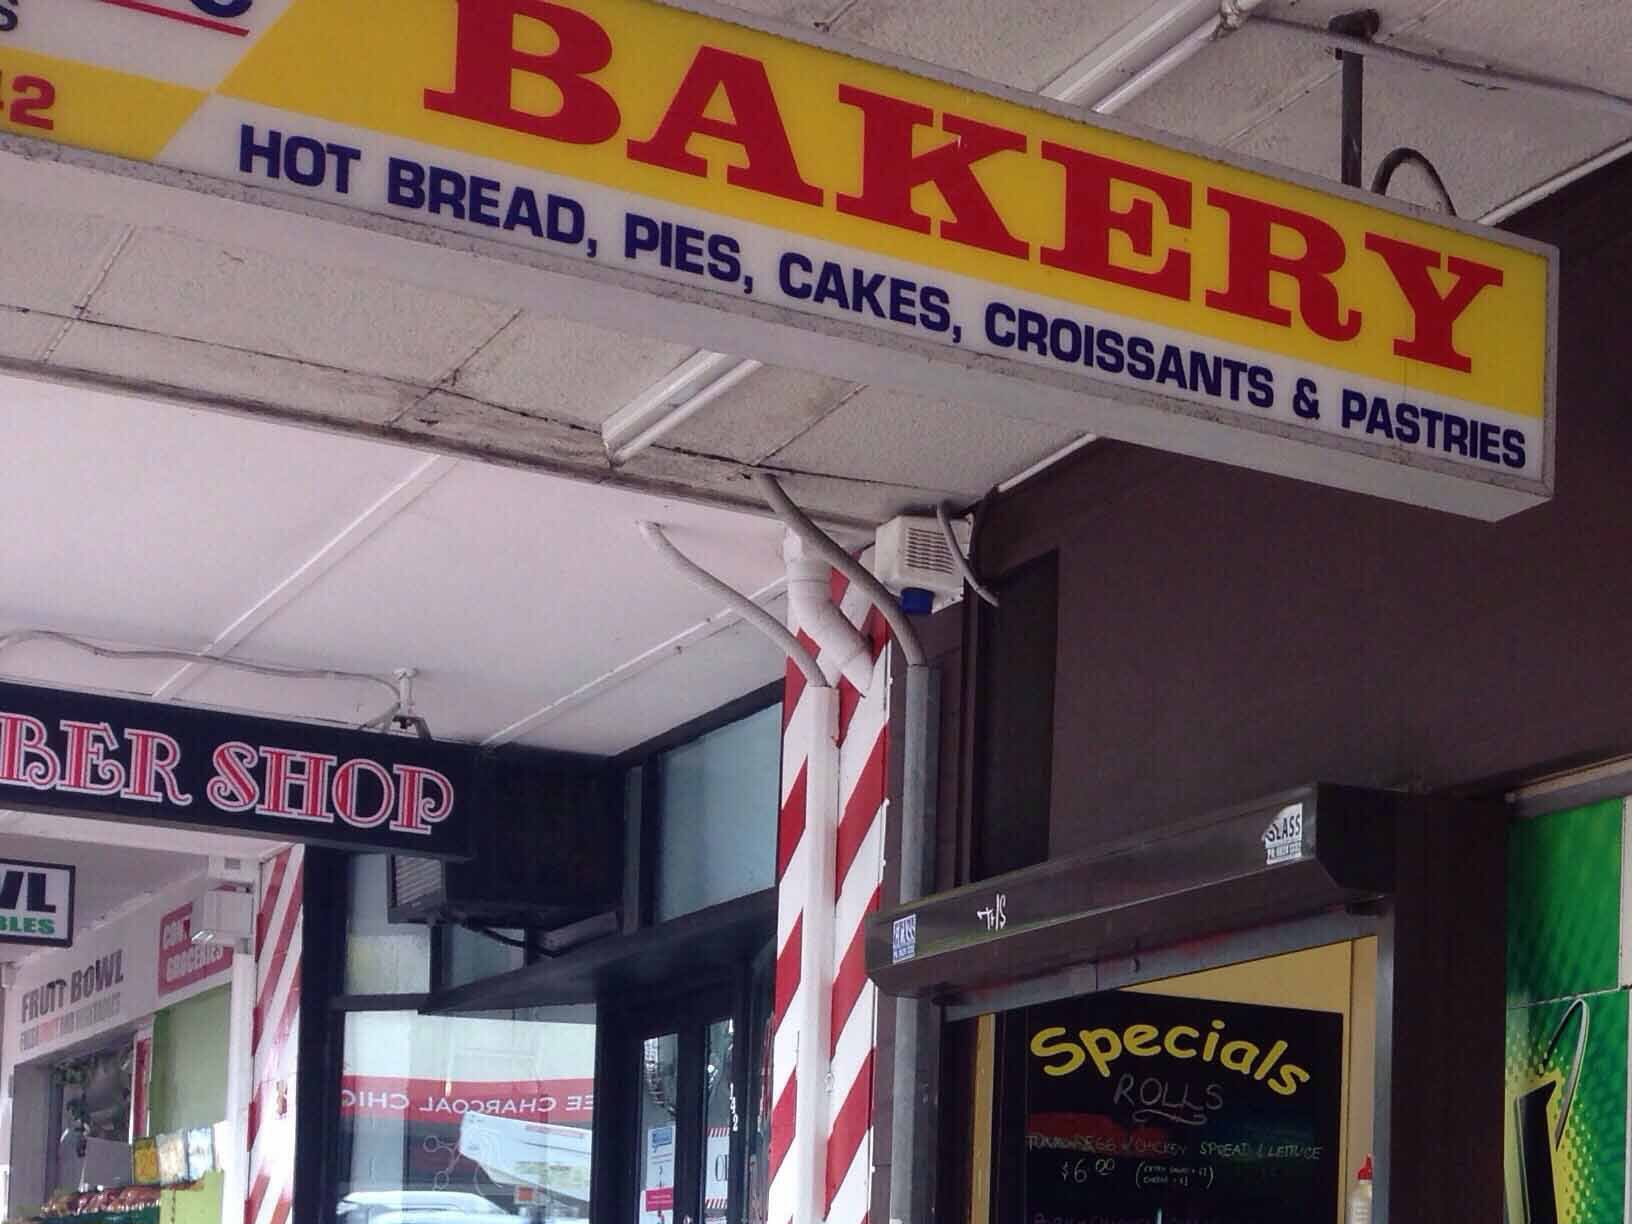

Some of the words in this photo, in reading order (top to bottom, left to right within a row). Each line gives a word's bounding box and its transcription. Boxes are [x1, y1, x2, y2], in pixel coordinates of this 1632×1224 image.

[0, 69, 56, 130] 2
[423, 0, 1504, 373] BAKERY
[239, 124, 361, 194] HOT
[387, 156, 598, 258] BREAD,
[625, 213, 753, 295] PIES,
[779, 252, 961, 343] CAKES,
[984, 301, 1273, 408] CROISSANTS
[1293, 377, 1320, 419] &
[1341, 389, 1526, 469] PASTRIES
[0, 712, 192, 806] BER
[206, 741, 454, 836] SHOP
[22, 979, 66, 1024] FRUIT
[71, 949, 124, 1003] BOWL
[1030, 1019, 1310, 1096] Specials
[1114, 1074, 1224, 1111] ROLLS
